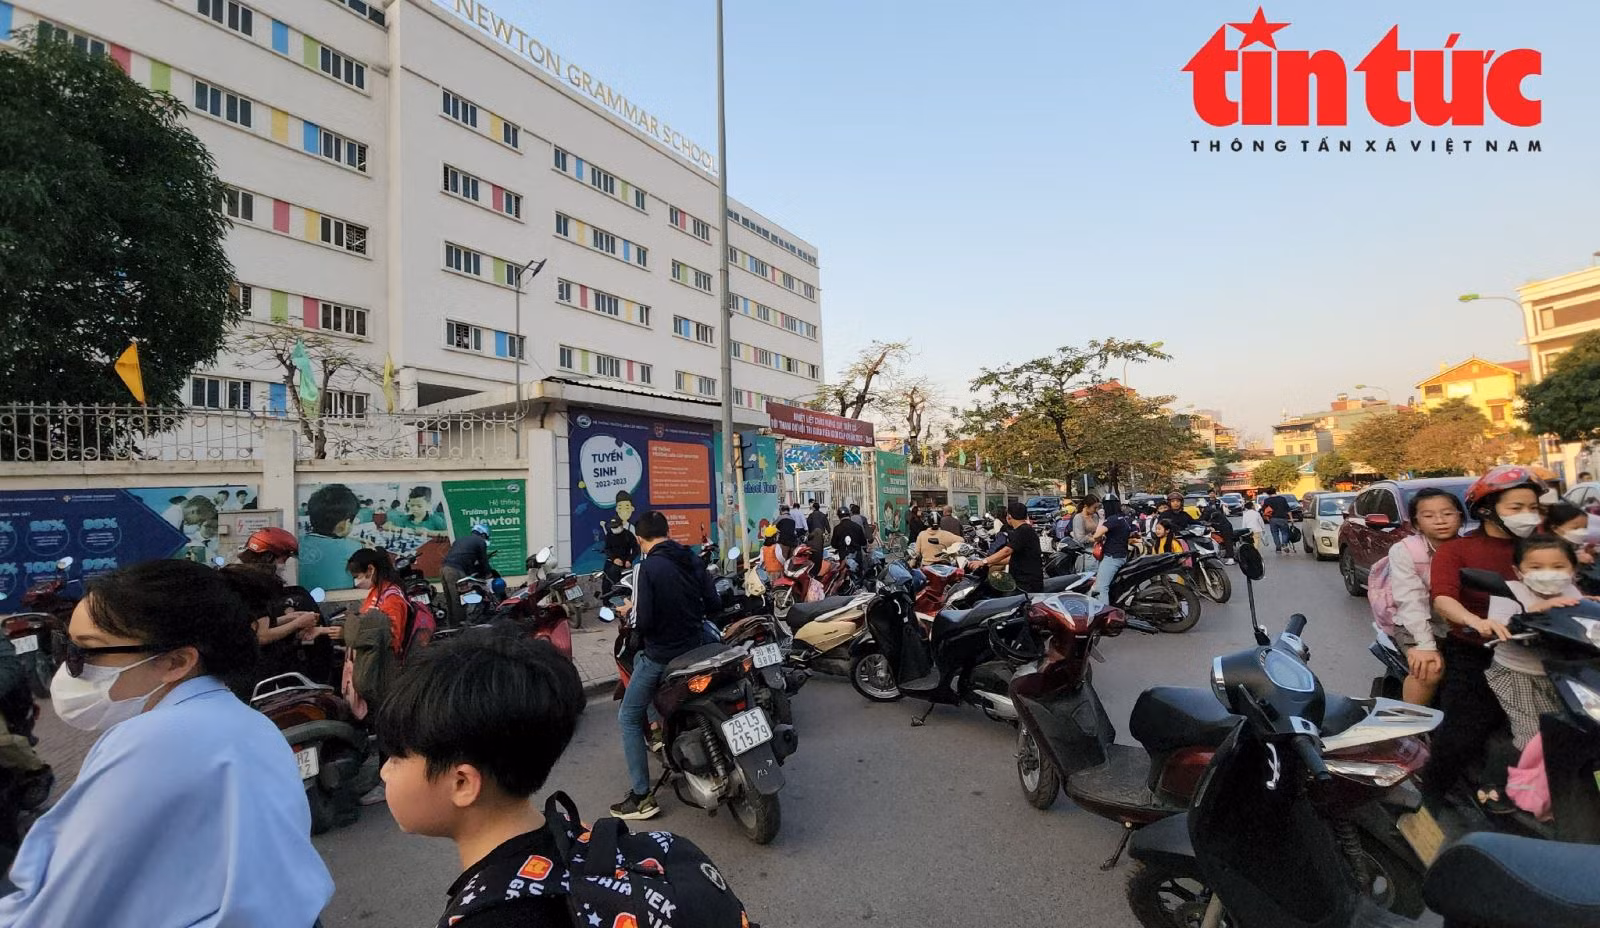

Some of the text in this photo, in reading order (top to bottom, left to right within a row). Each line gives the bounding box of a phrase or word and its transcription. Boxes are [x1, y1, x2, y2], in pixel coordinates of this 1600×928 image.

[454, 0, 719, 174] NEWTON GRAMMAR SCHOOL
[593, 466, 617, 477] SINH
[595, 478, 627, 488] 2022-2023
[469, 516, 520, 527] Newton
[728, 711, 760, 736] 29-L5
[731, 724, 770, 753] 215.79
